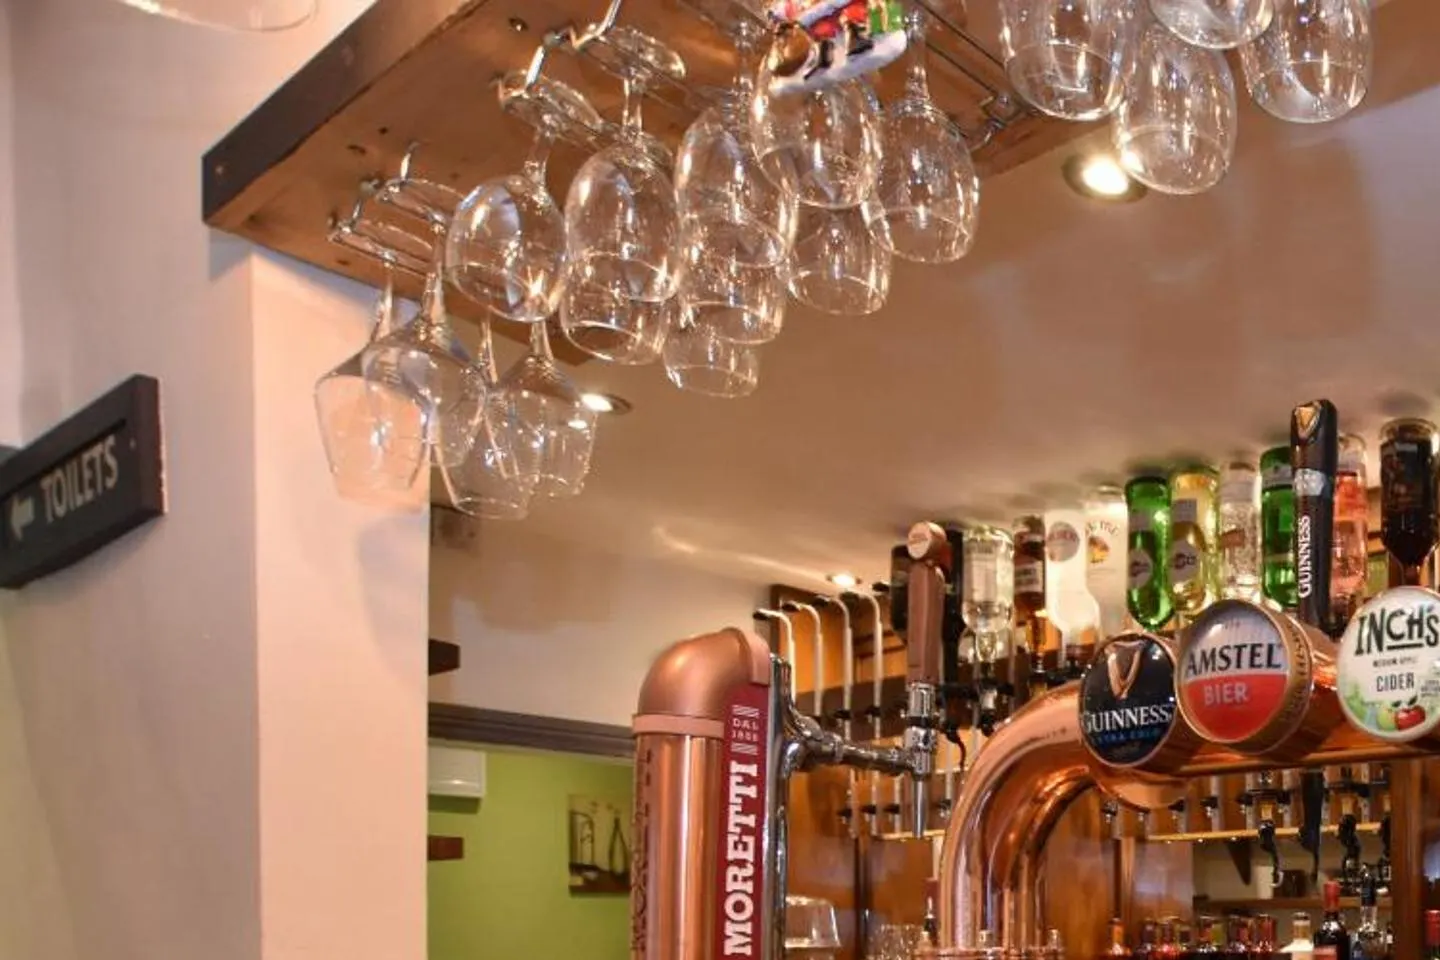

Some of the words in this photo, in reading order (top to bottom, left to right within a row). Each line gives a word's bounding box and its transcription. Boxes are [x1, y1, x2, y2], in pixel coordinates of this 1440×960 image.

[41, 434, 118, 523] TOILETS
[1299, 516, 1313, 599] GUINNESS
[1186, 643, 1282, 677] AMSTEL
[1376, 672, 1415, 693] CIDER
[1203, 682, 1248, 706] BIER
[724, 760, 758, 956] MORETTI
